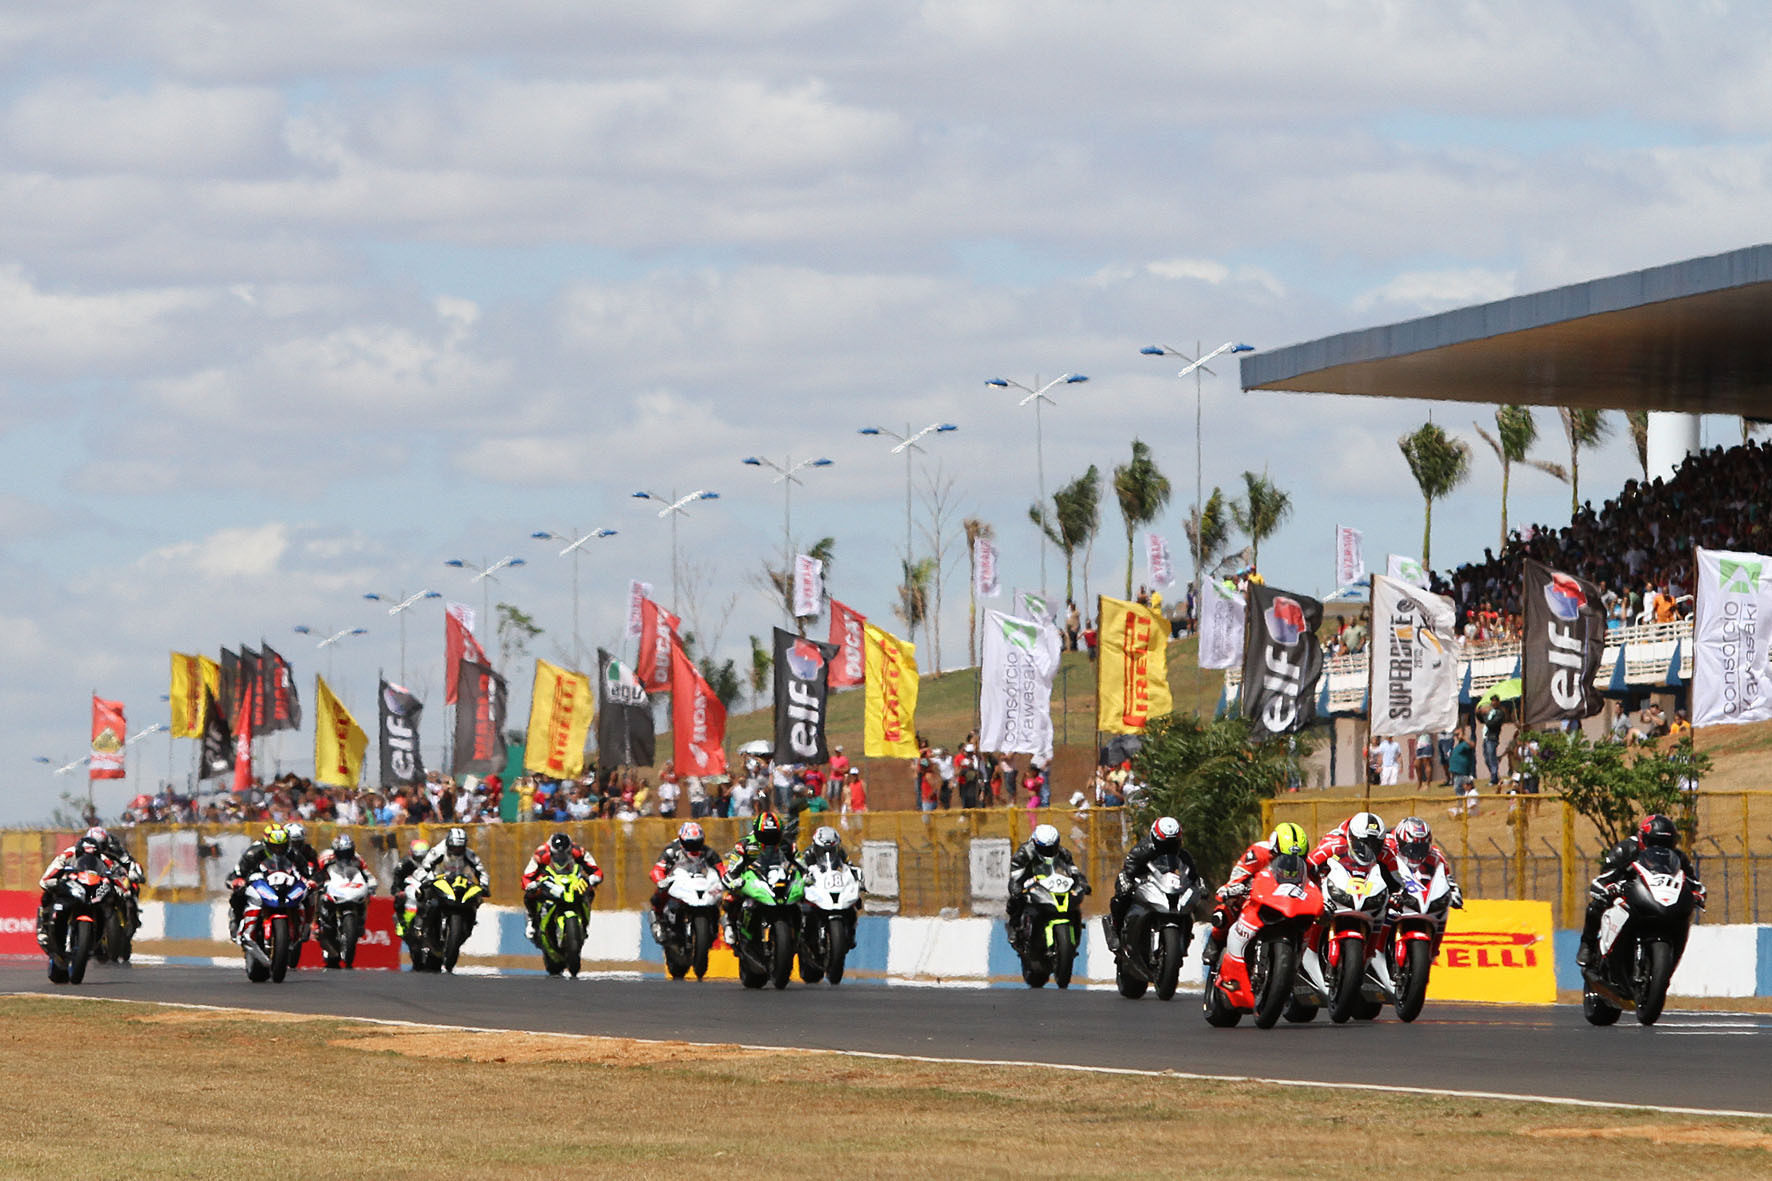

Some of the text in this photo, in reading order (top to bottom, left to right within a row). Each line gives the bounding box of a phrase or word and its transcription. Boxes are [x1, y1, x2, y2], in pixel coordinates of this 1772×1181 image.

[1123, 611, 1151, 728] PIRELLI
[1262, 645, 1300, 733] elf
[1389, 614, 1413, 719] SUPERBIKE
[1548, 621, 1582, 710] elf
[386, 716, 414, 780] elf
[788, 680, 819, 757] elf
